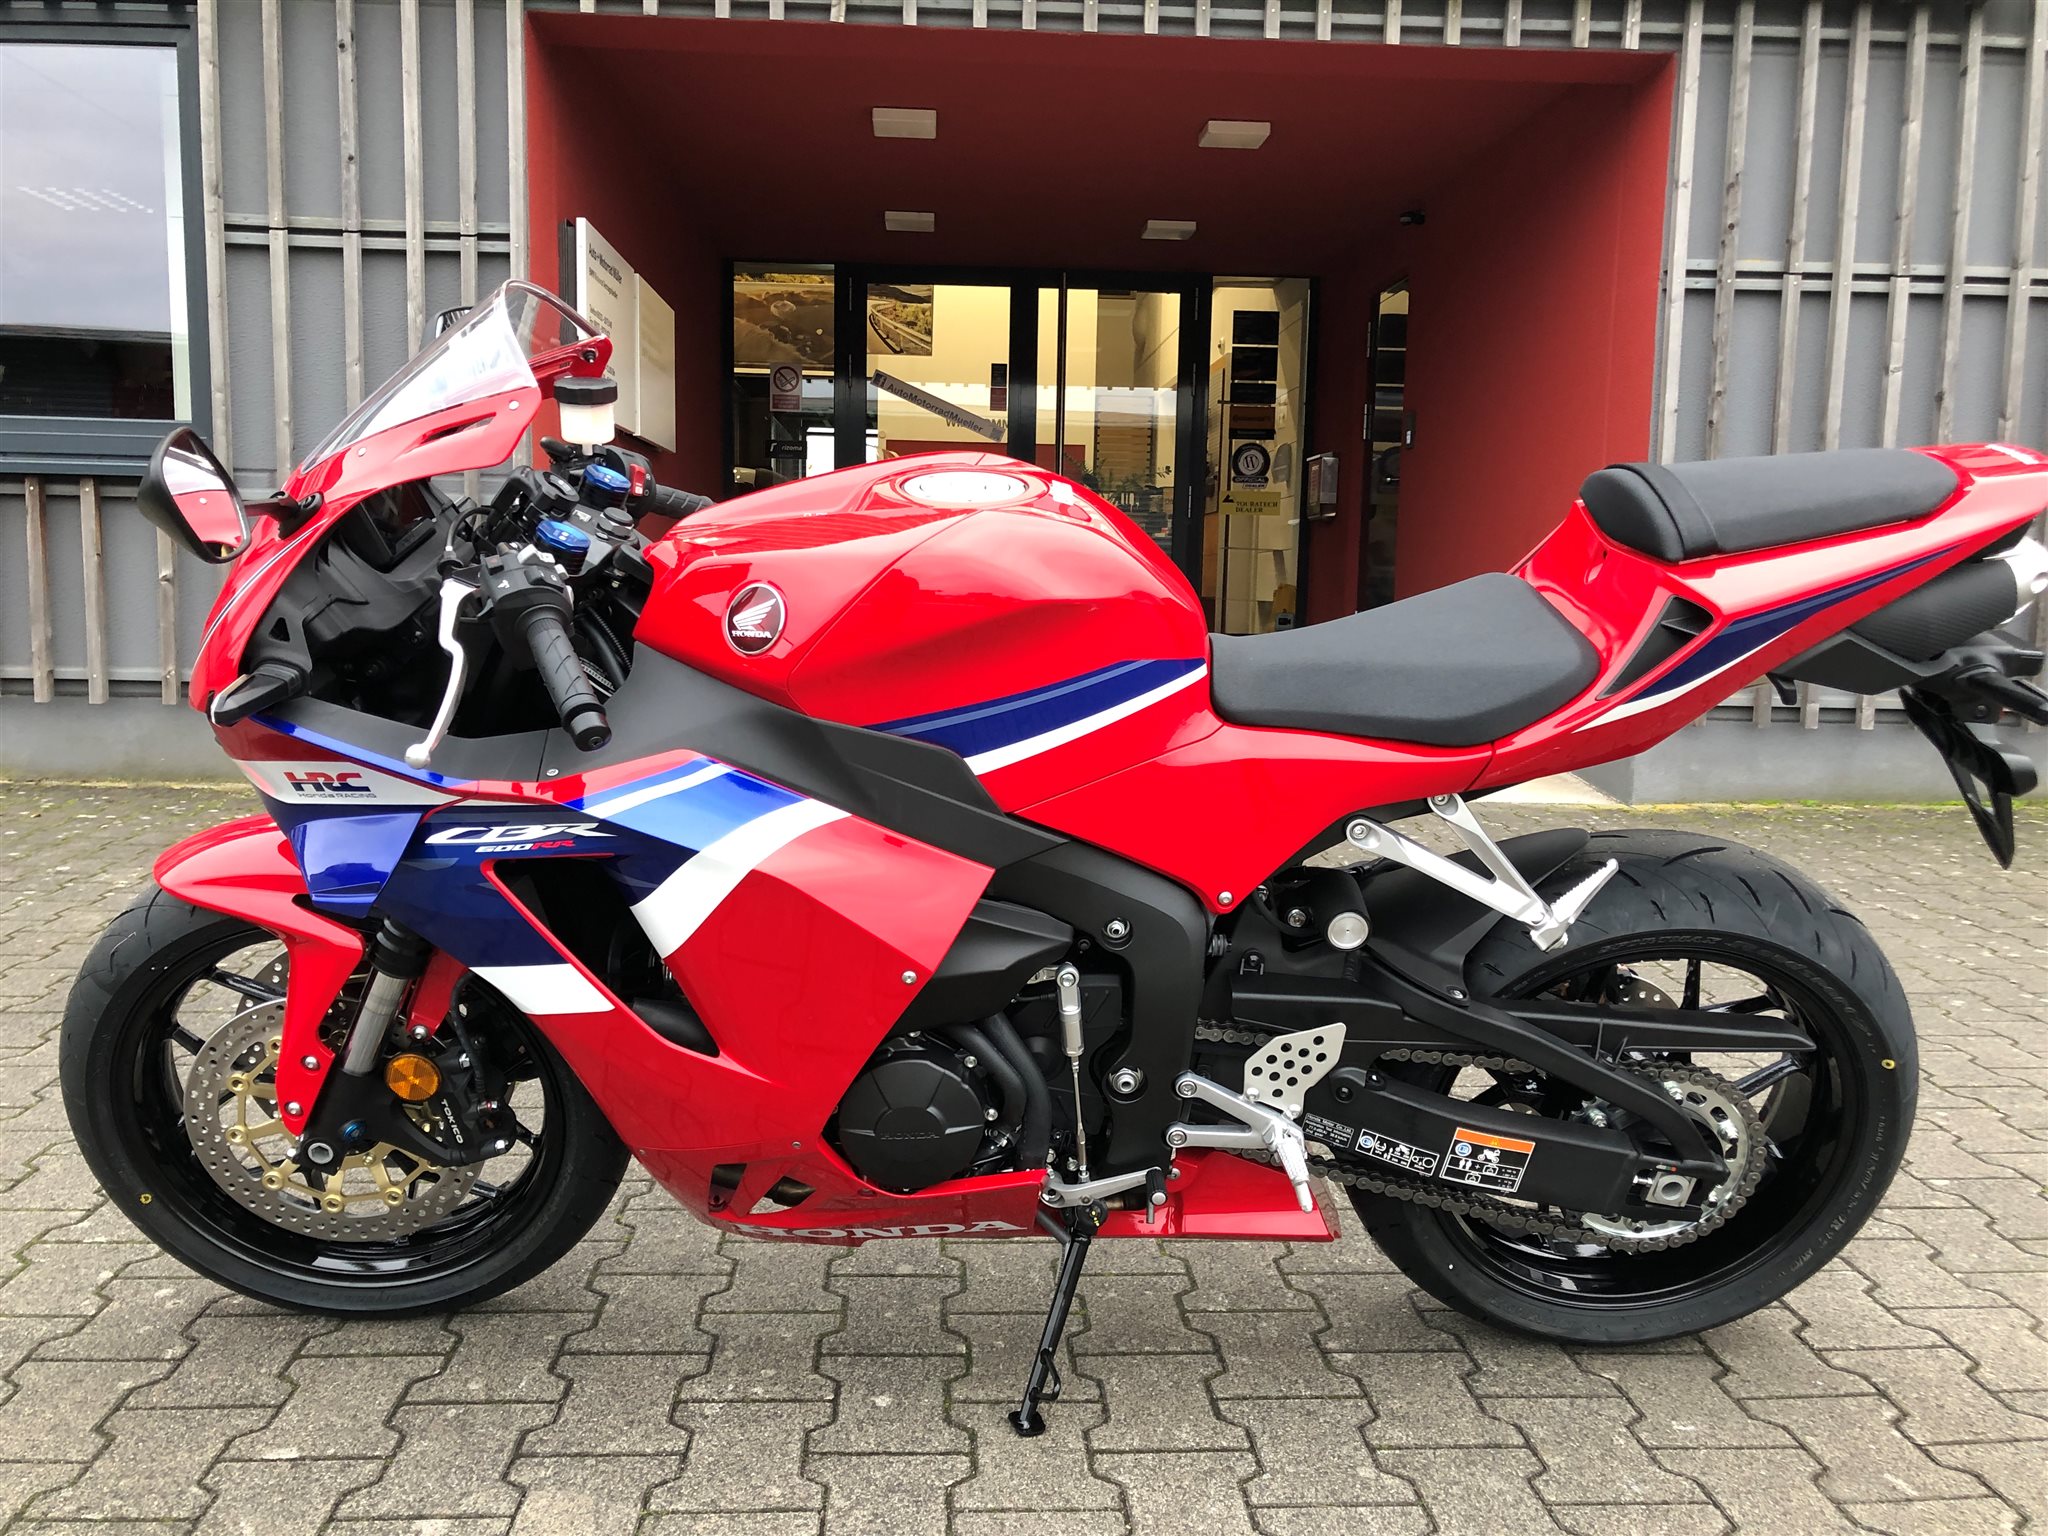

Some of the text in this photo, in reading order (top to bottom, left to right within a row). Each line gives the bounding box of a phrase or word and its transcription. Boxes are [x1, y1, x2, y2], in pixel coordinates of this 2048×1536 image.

[887, 383, 984, 433] AutoMotorradMueller
[731, 630, 773, 639] HONDA
[283, 772, 371, 792] HRC
[424, 822, 617, 844] CBR
[474, 839, 576, 853] 600RR
[440, 1098, 464, 1145] TOKICO
[880, 1131, 941, 1140] HONDA
[732, 1220, 1028, 1238] HONDA
